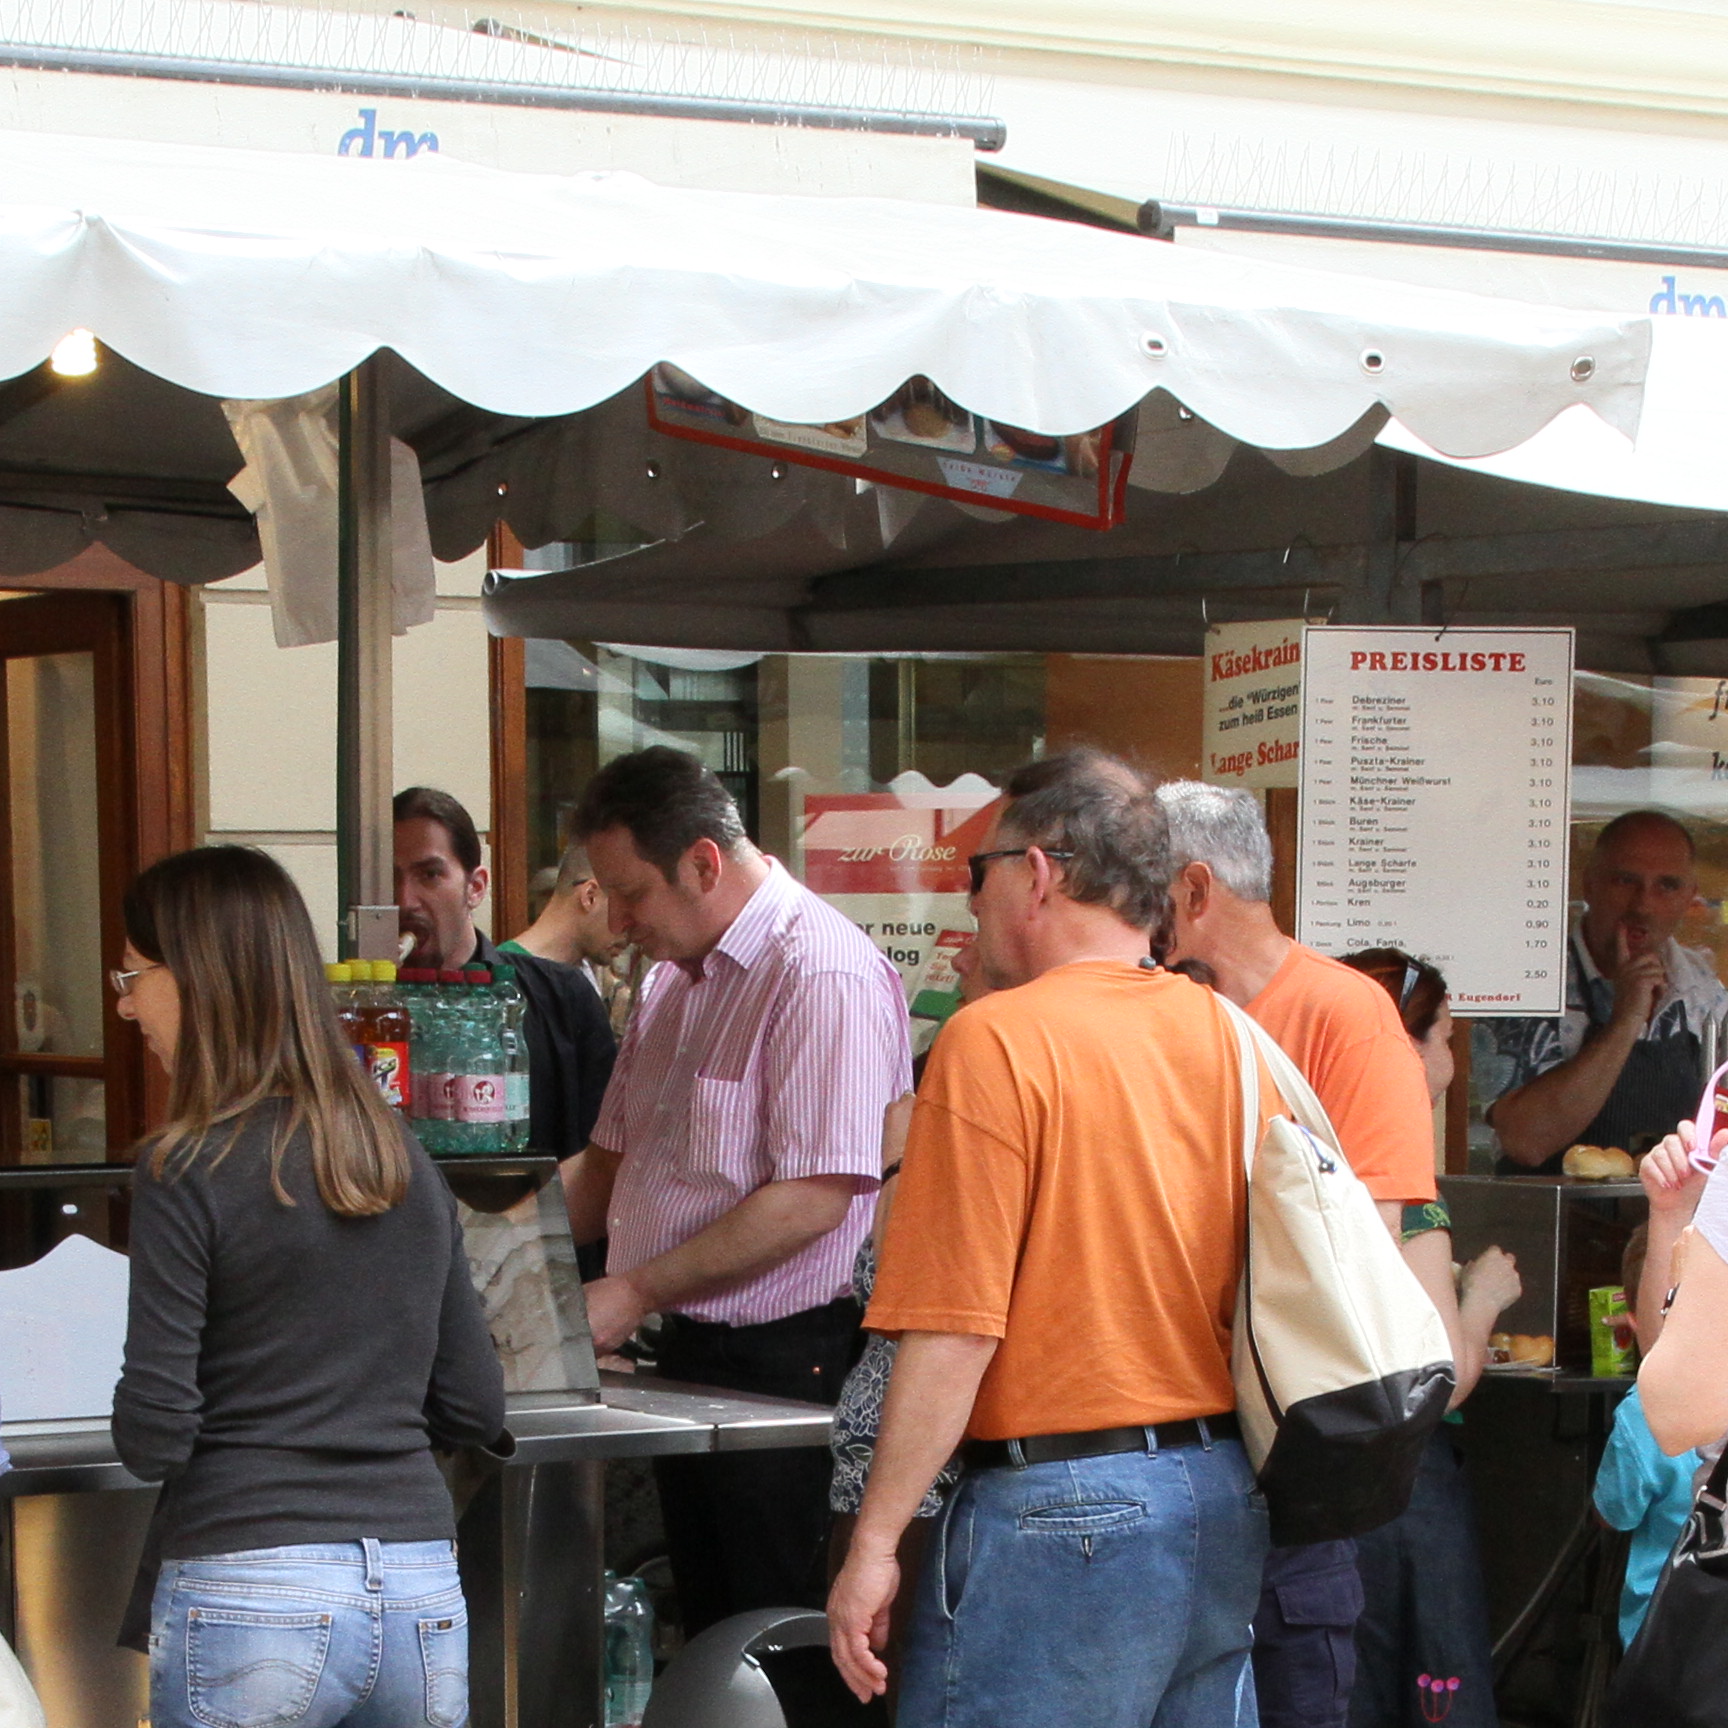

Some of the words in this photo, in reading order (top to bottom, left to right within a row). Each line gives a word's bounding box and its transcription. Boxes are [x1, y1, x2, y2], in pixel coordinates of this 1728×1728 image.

[337, 108, 439, 159] dm
[1649, 275, 1727, 318] dm
[1350, 651, 1526, 672] PREISLISTE
[1352, 695, 1406, 705] Debreziner
[1531, 697, 1555, 706] 3.10
[1218, 716, 1240, 732] zum
[1242, 708, 1264, 727] heiß
[1267, 703, 1298, 720] Essen
[1351, 715, 1407, 725] Frankfurter
[1530, 717, 1554, 727] 3.10
[1351, 736, 1388, 745] Frische
[1530, 738, 1553, 747] 3.10
[1350, 756, 1426, 766] Puszta-Krainer
[1529, 758, 1553, 767] 3.10
[1350, 776, 1398, 786] Münchner
[1402, 776, 1452, 786] Weißwurst
[1529, 778, 1552, 787] 3.10
[1349, 796, 1416, 806] Käse-Krainer
[1528, 799, 1552, 808] 3.10
[1349, 817, 1379, 826] Buren
[1528, 819, 1551, 828] 3.10
[837, 846, 886, 862] zur
[888, 833, 957, 862] Rose
[1348, 837, 1384, 846] Krainer
[1527, 839, 1551, 848] 3.10
[1348, 859, 1377, 869] Lange
[1527, 859, 1550, 868] 3.10
[1348, 879, 1406, 889] Augsburger
[1527, 880, 1550, 888] 3.10
[1347, 898, 1371, 906] Kren
[1527, 900, 1549, 908] 0.20
[1347, 918, 1371, 927] Limo
[1526, 920, 1549, 929] 0.90
[881, 923, 936, 936] neue
[1525, 940, 1548, 948] 1.70
[1524, 970, 1548, 979] 2.50
[1458, 993, 1521, 1003] Eugendorf
